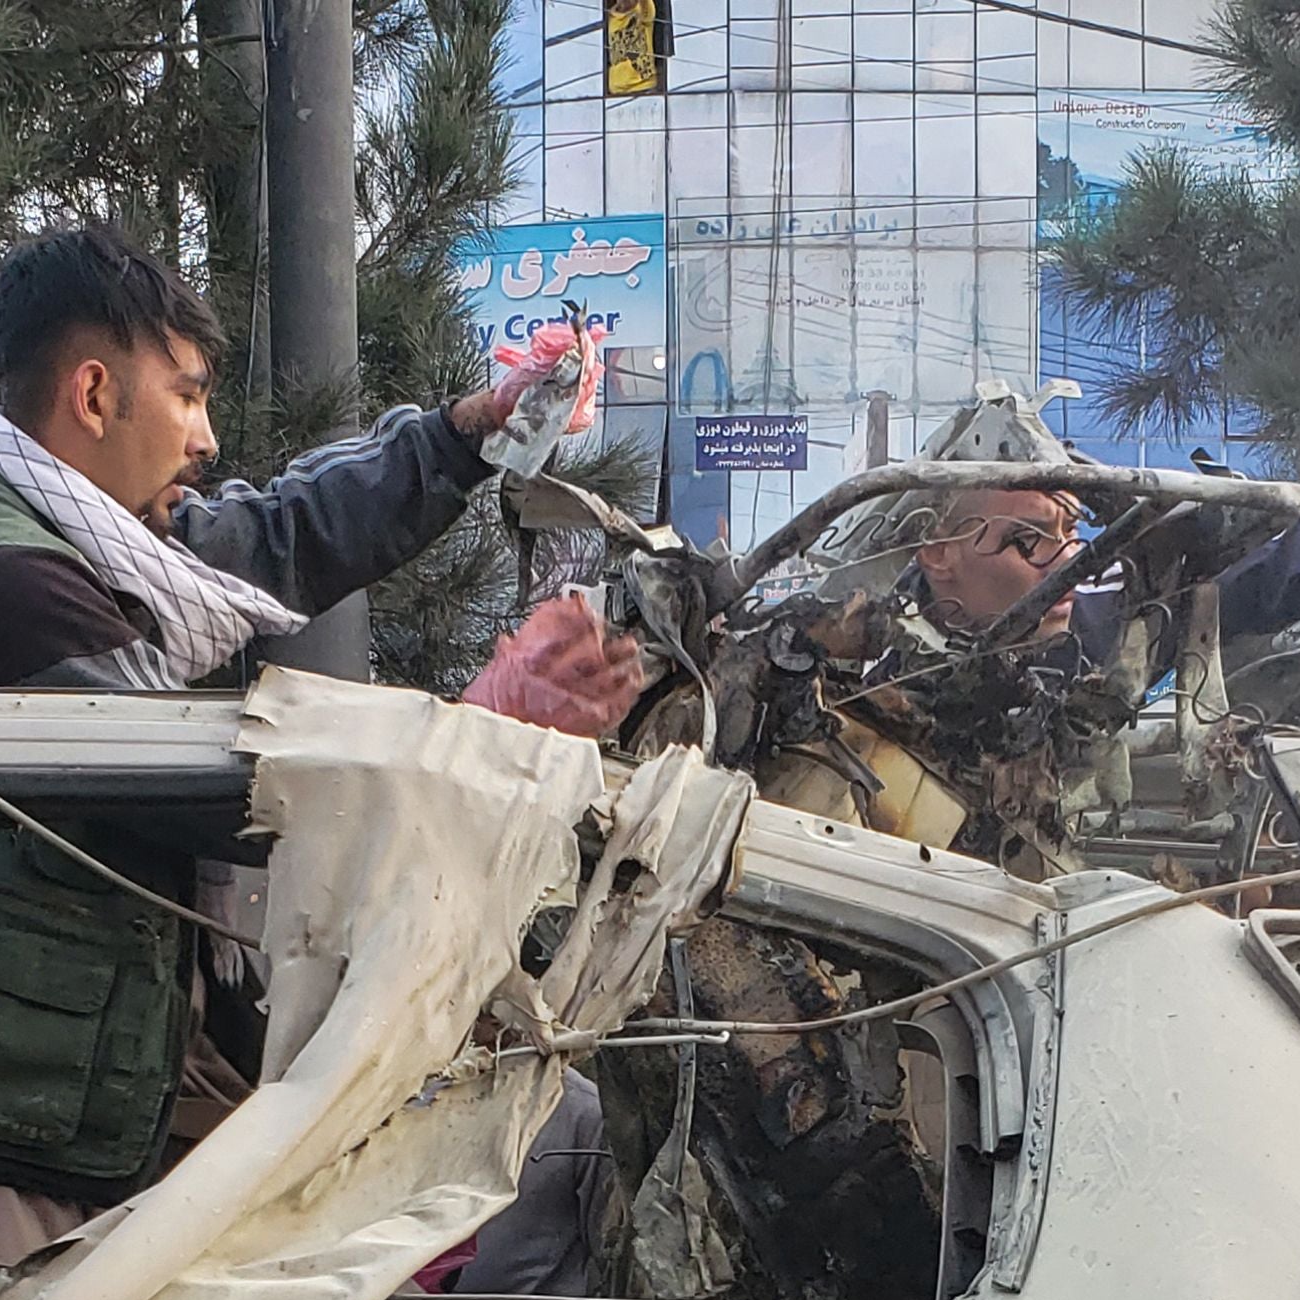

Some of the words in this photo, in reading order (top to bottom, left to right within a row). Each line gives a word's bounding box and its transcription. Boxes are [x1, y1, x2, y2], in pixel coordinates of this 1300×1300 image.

[1053, 100, 1098, 117] Unique
[1105, 102, 1151, 118] Design
[1095, 117, 1146, 130] Construction
[1146, 119, 1187, 131] Company
[501, 226, 652, 299] جعفری
[504, 311, 622, 340] Ceer
[785, 443, 796, 456] در
